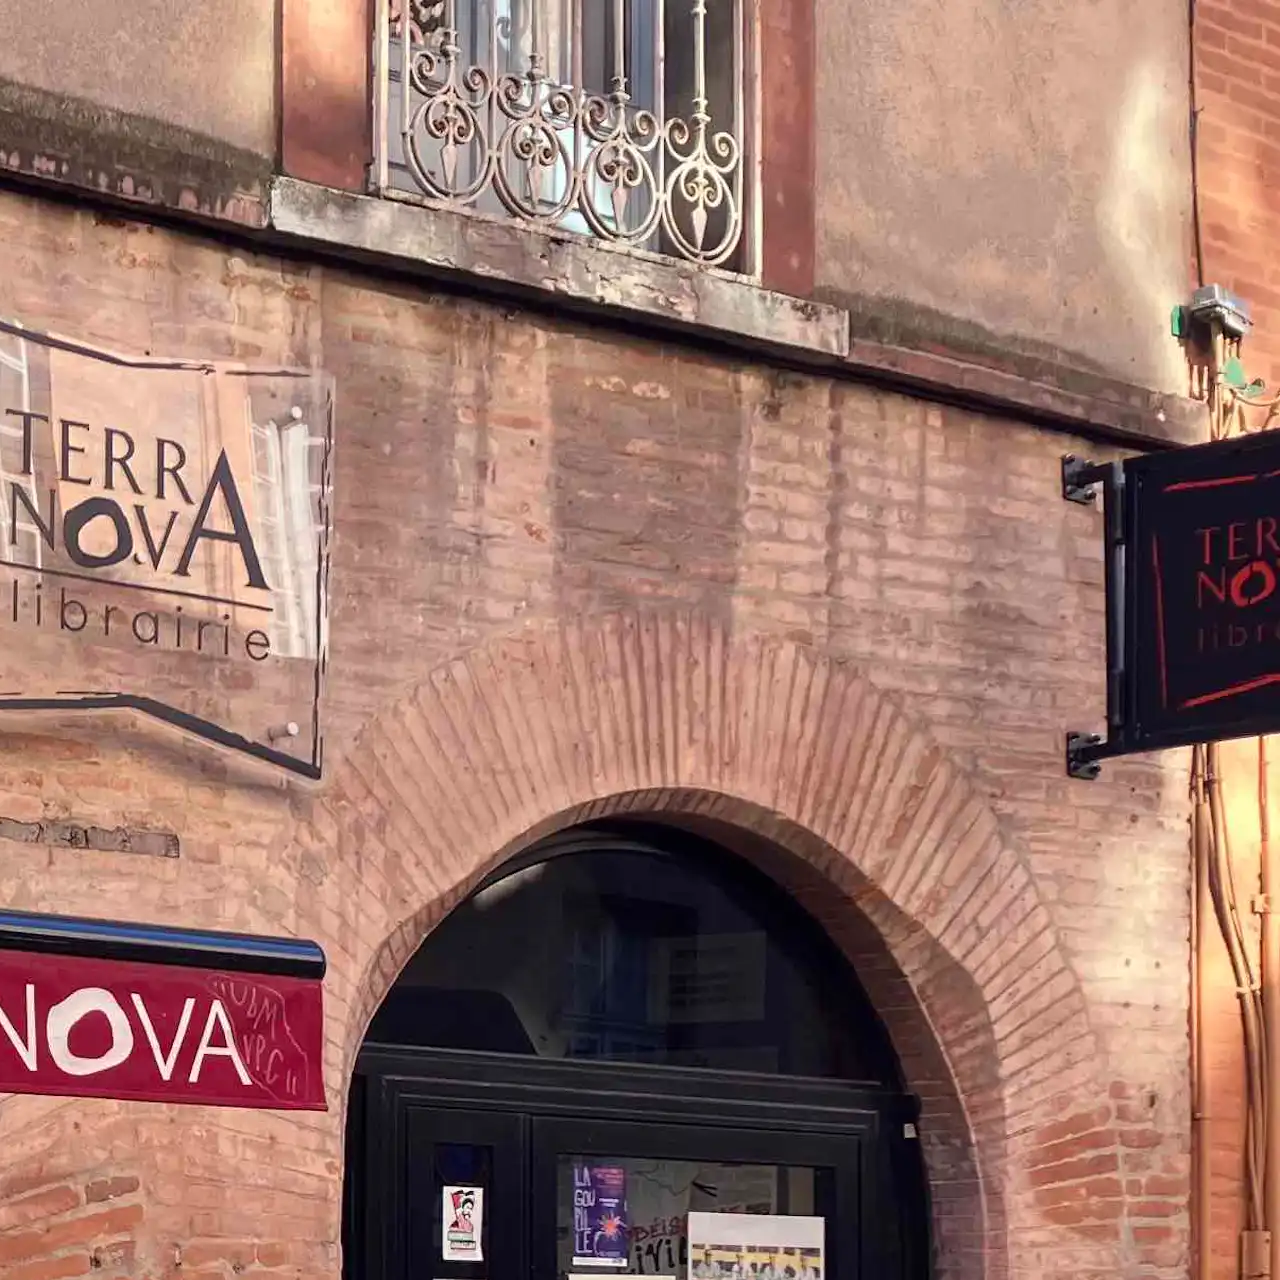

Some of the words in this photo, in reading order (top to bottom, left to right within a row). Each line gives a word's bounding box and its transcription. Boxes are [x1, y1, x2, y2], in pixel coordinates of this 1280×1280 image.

[10, 449, 271, 589] NOVA
[13, 580, 271, 662] librairie
[1196, 560, 1280, 609] NO
